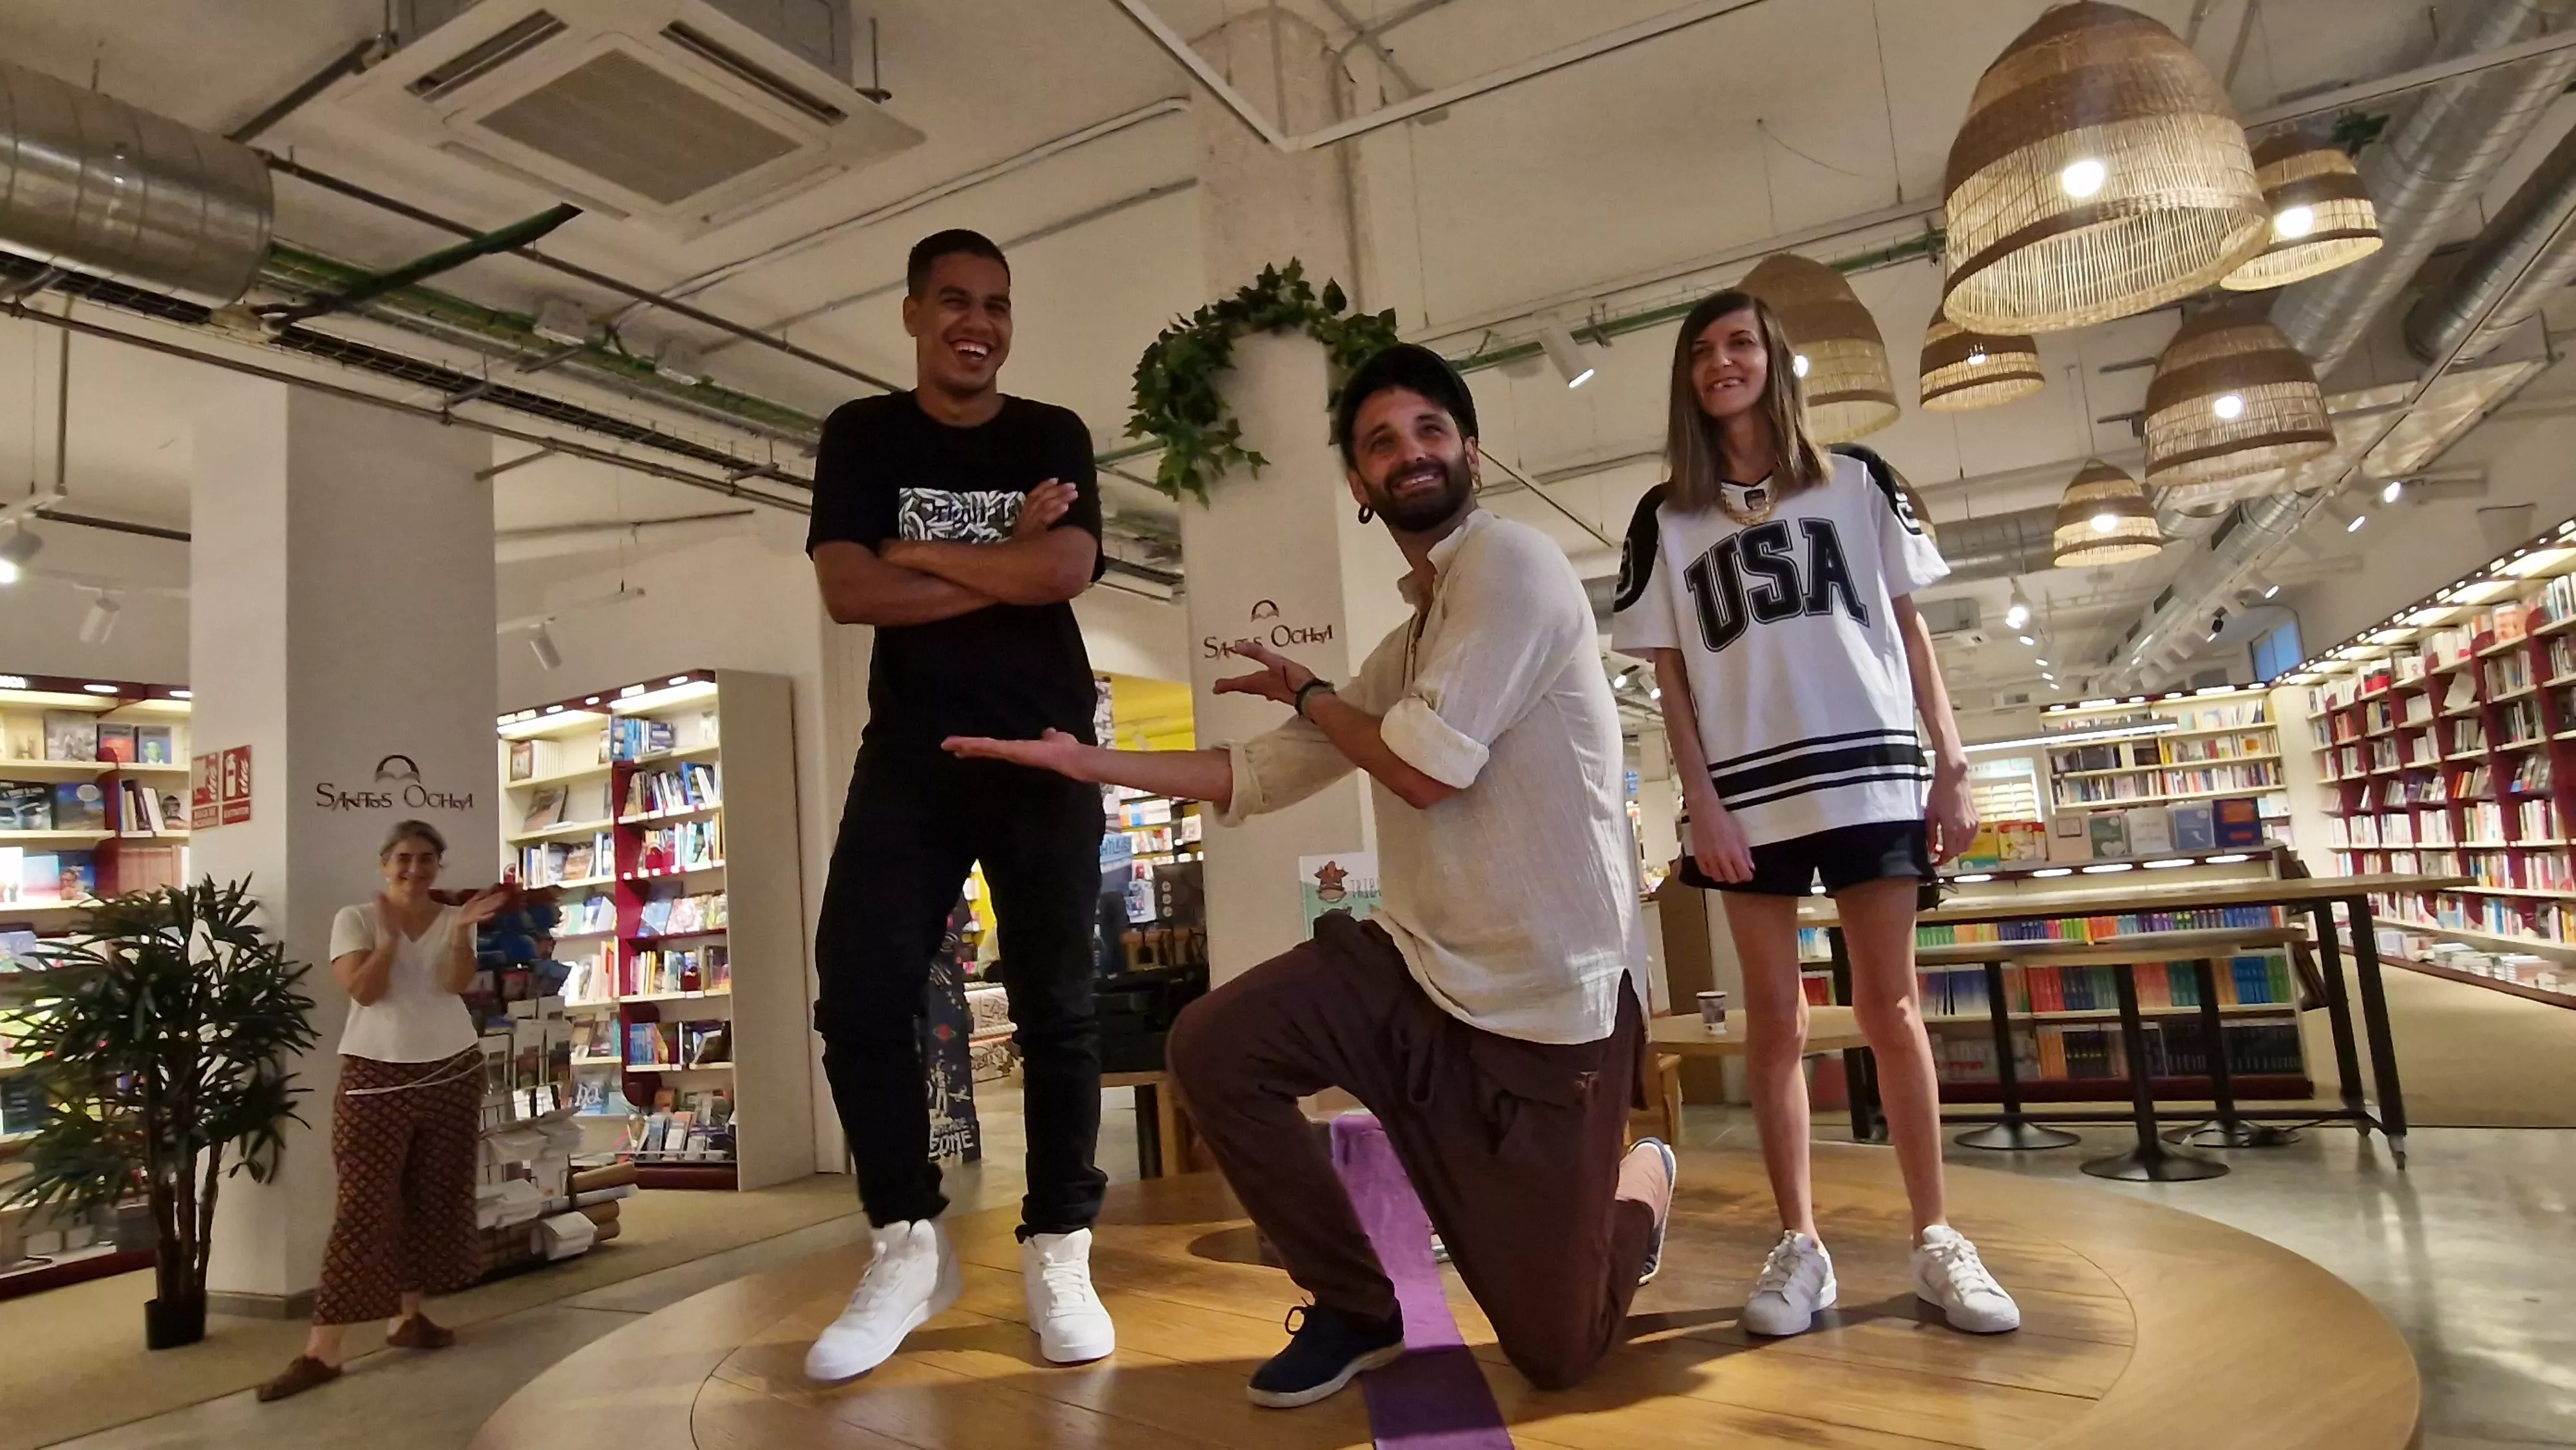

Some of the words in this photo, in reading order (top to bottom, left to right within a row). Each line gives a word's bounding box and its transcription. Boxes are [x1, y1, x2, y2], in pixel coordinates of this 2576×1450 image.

[1683, 517, 1870, 653] USA
[1271, 624, 1333, 648] OCHOA
[316, 782, 393, 811] SANTOS
[404, 784, 474, 811] OCHOA
